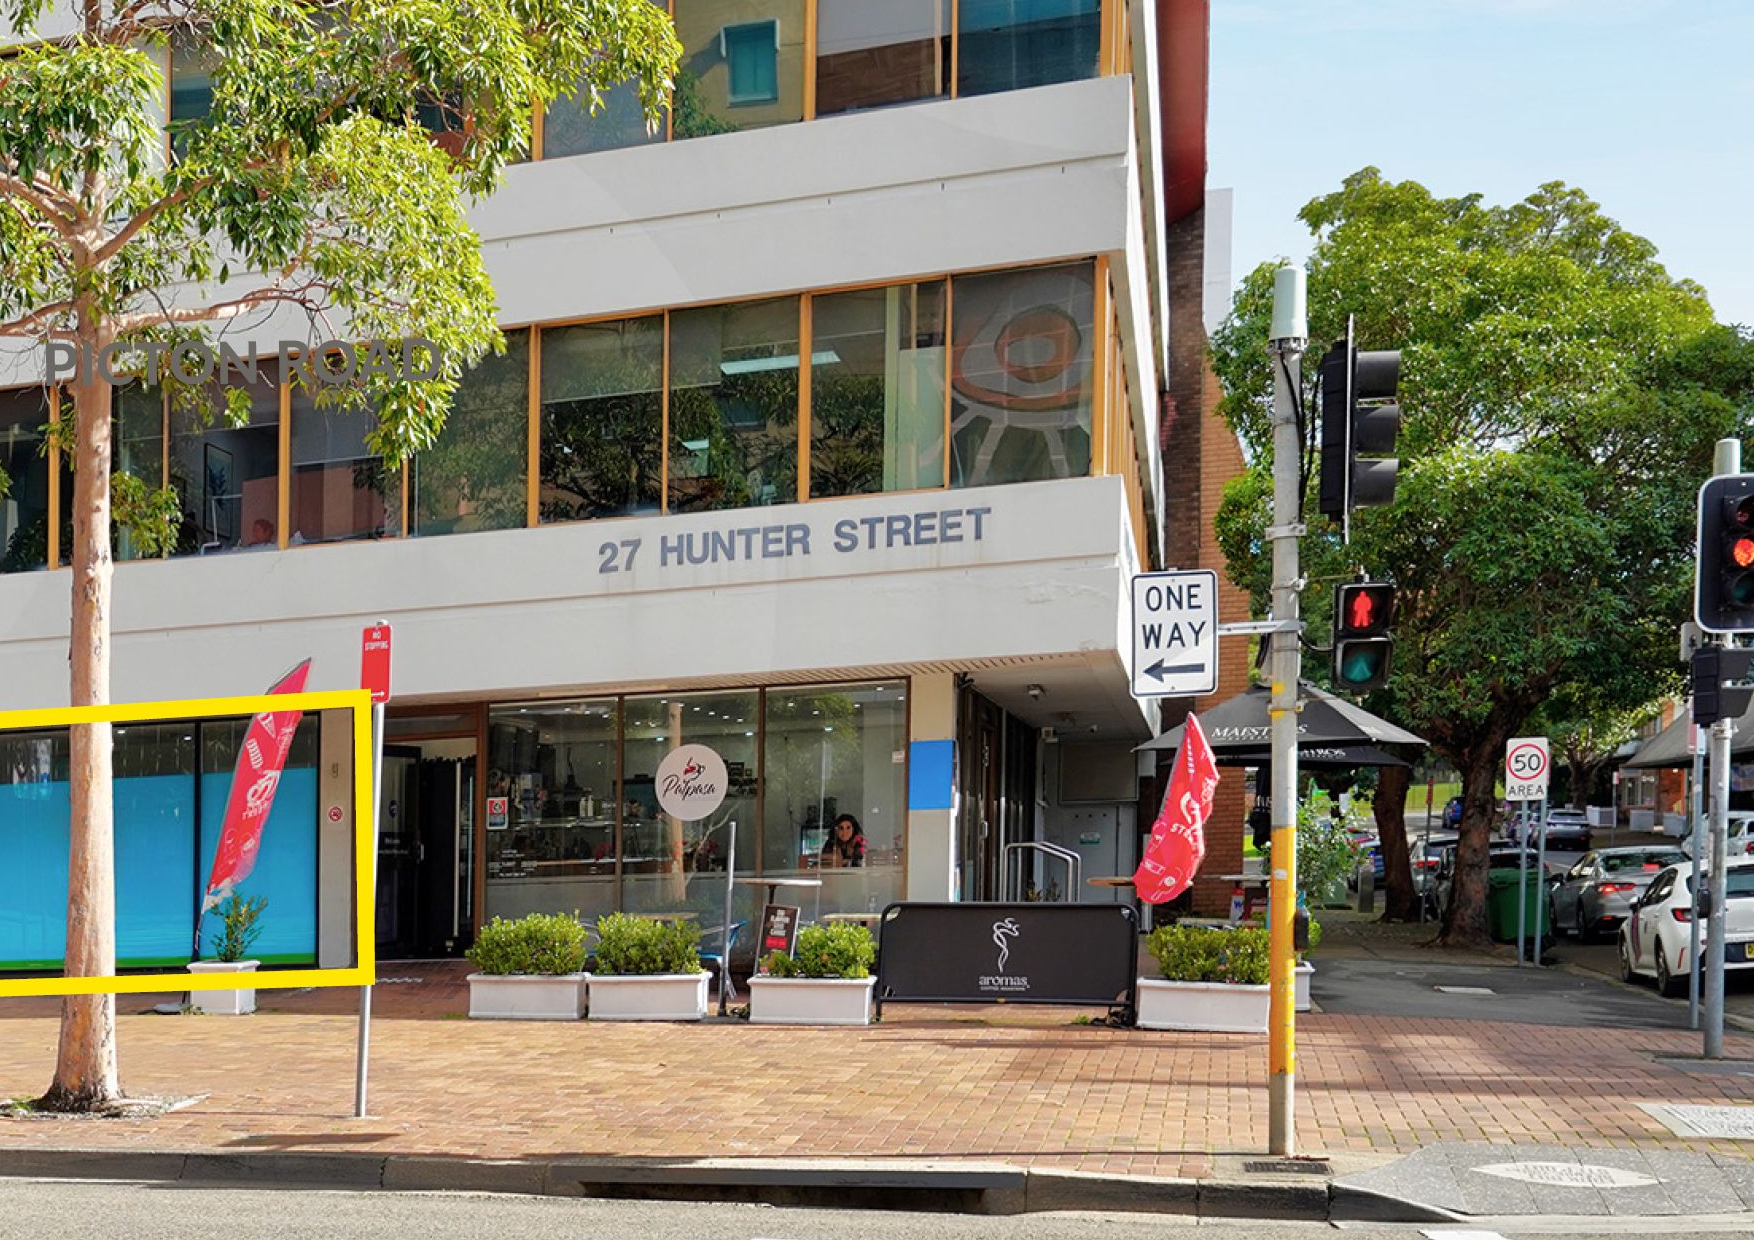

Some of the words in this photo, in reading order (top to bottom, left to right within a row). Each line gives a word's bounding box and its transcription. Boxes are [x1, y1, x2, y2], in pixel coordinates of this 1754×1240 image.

[598, 539, 642, 574] 27
[660, 524, 811, 567] HUNTER
[833, 507, 992, 553] STREET
[1146, 584, 1202, 612] ONE
[1142, 621, 1206, 649] WAY
[1212, 724, 1308, 738] MAESTS
[1514, 754, 1541, 772] 50
[1508, 784, 1544, 797] AREA
